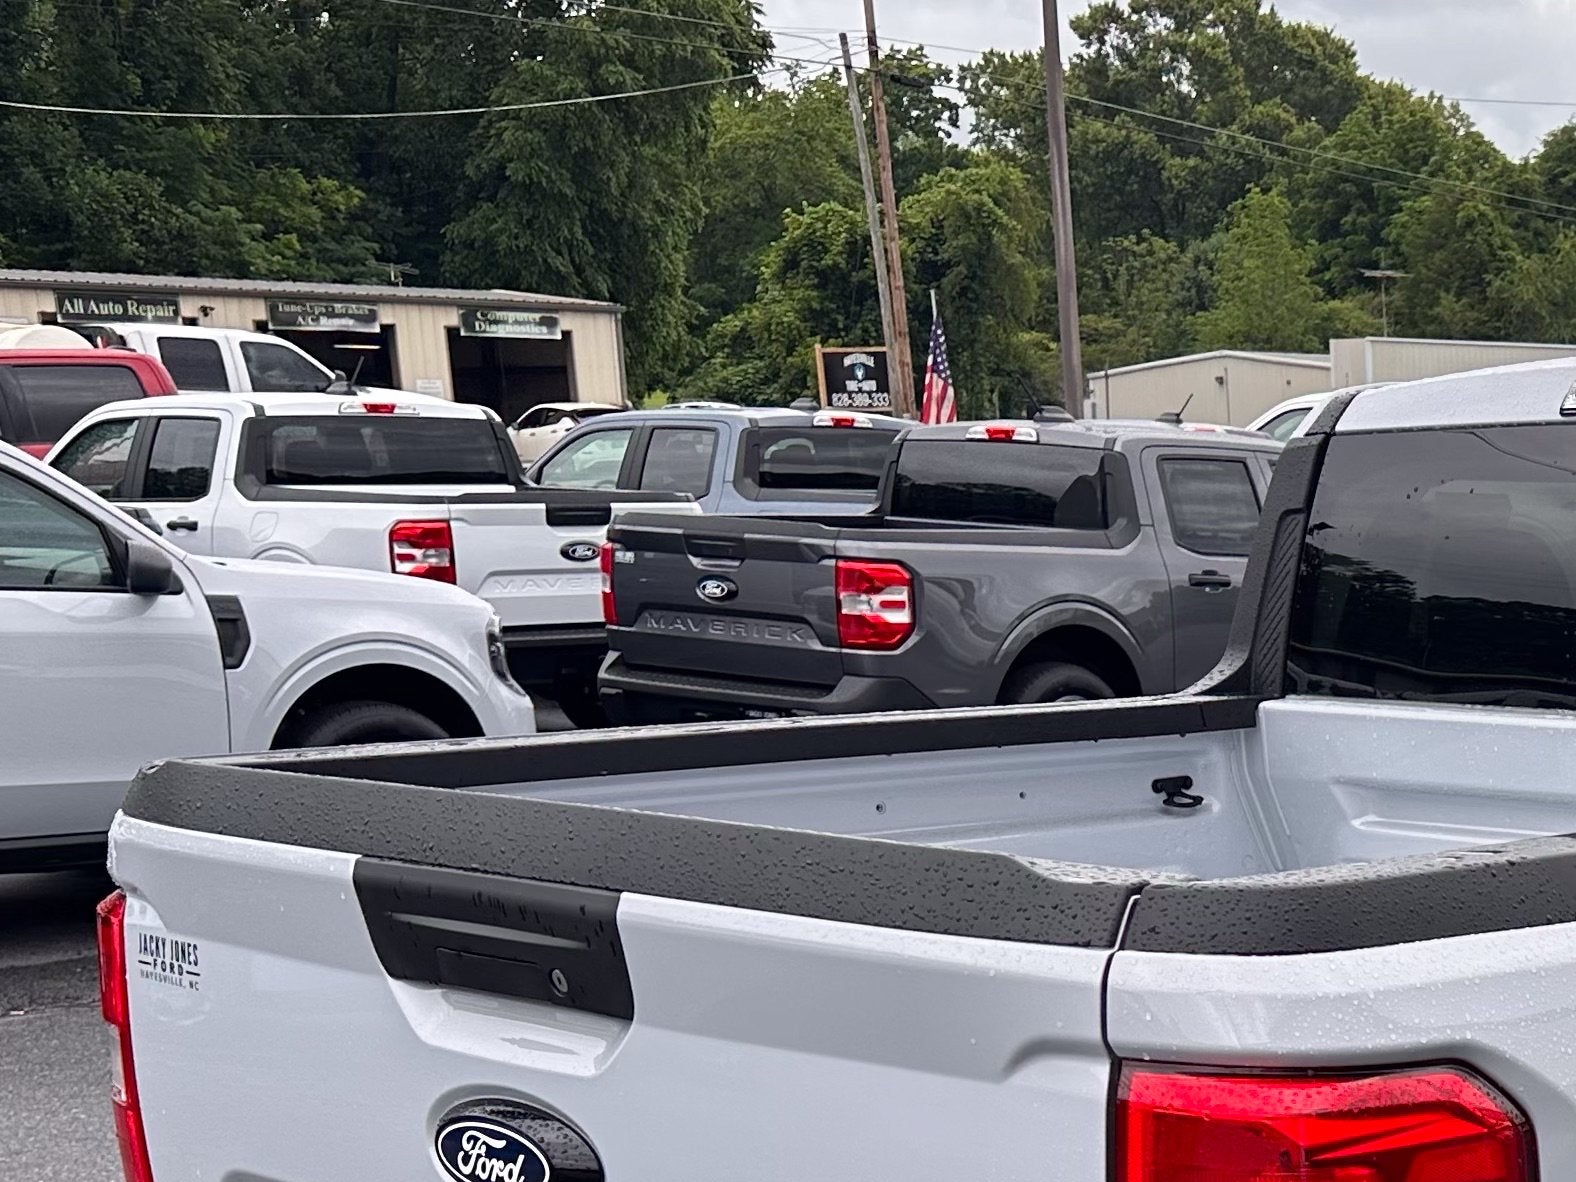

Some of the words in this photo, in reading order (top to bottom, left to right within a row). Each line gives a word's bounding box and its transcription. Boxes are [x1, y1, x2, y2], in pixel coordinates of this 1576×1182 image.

[62, 298, 84, 314] All
[87, 300, 123, 315] Auto
[126, 300, 177, 321] Repair
[474, 321, 548, 335] Diagnostics
[645, 612, 805, 643] MAVERICK
[138, 932, 167, 960] JACKY
[170, 938, 199, 967] JONES
[153, 958, 184, 977] FORD
[188, 980, 200, 992] NC
